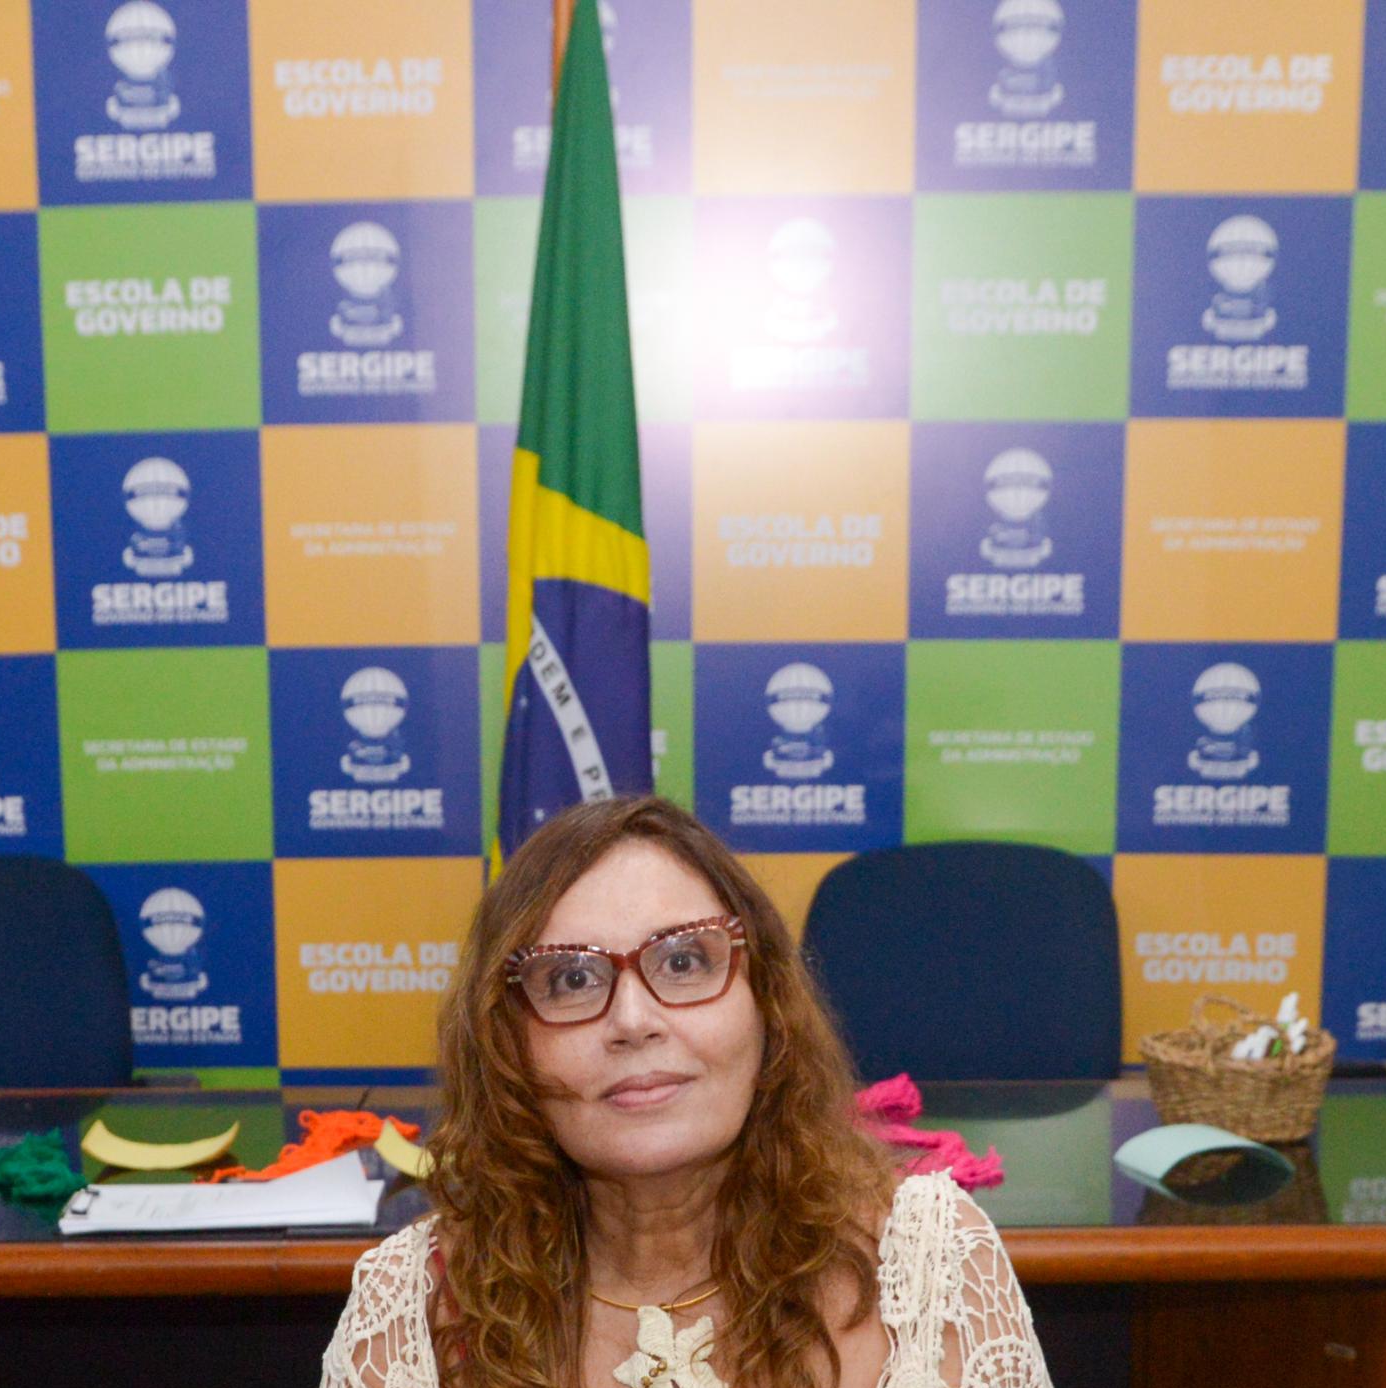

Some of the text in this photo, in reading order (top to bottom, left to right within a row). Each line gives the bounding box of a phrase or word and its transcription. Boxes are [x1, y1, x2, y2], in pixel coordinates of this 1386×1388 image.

[274, 59, 442, 89] ESCOLA DE
[1162, 55, 1332, 85] ESCOLA DE
[282, 87, 437, 118] GOVERNO
[1168, 83, 1324, 113] GOVERNO
[76, 134, 215, 165] SERGIPE
[513, 126, 651, 154] SEPE
[957, 123, 1096, 151] SERGIPE
[65, 277, 231, 308] ESCOLA DE
[945, 279, 1107, 308] ESCOLA DE
[74, 306, 225, 336] GOVERNO
[949, 306, 1100, 335] GOVERNO
[298, 353, 434, 382] SERGIPE
[1169, 347, 1309, 375] SERGIPE
[720, 515, 882, 542] ESCOLA DE
[725, 540, 875, 568] GOVERNO
[93, 583, 228, 611] SERGIPE
[948, 576, 1085, 602] SERGIPE
[310, 790, 444, 817] SERGIPE
[732, 786, 866, 812] SERGIPE
[1155, 787, 1290, 812] SERGIPE
[300, 943, 458, 969] ESCOLA DE
[1135, 933, 1296, 960] ESCOLA DE
[307, 967, 451, 993] GOVERNO
[1141, 958, 1289, 984] GOVERNO
[130, 1006, 240, 1031] ERGIPE
